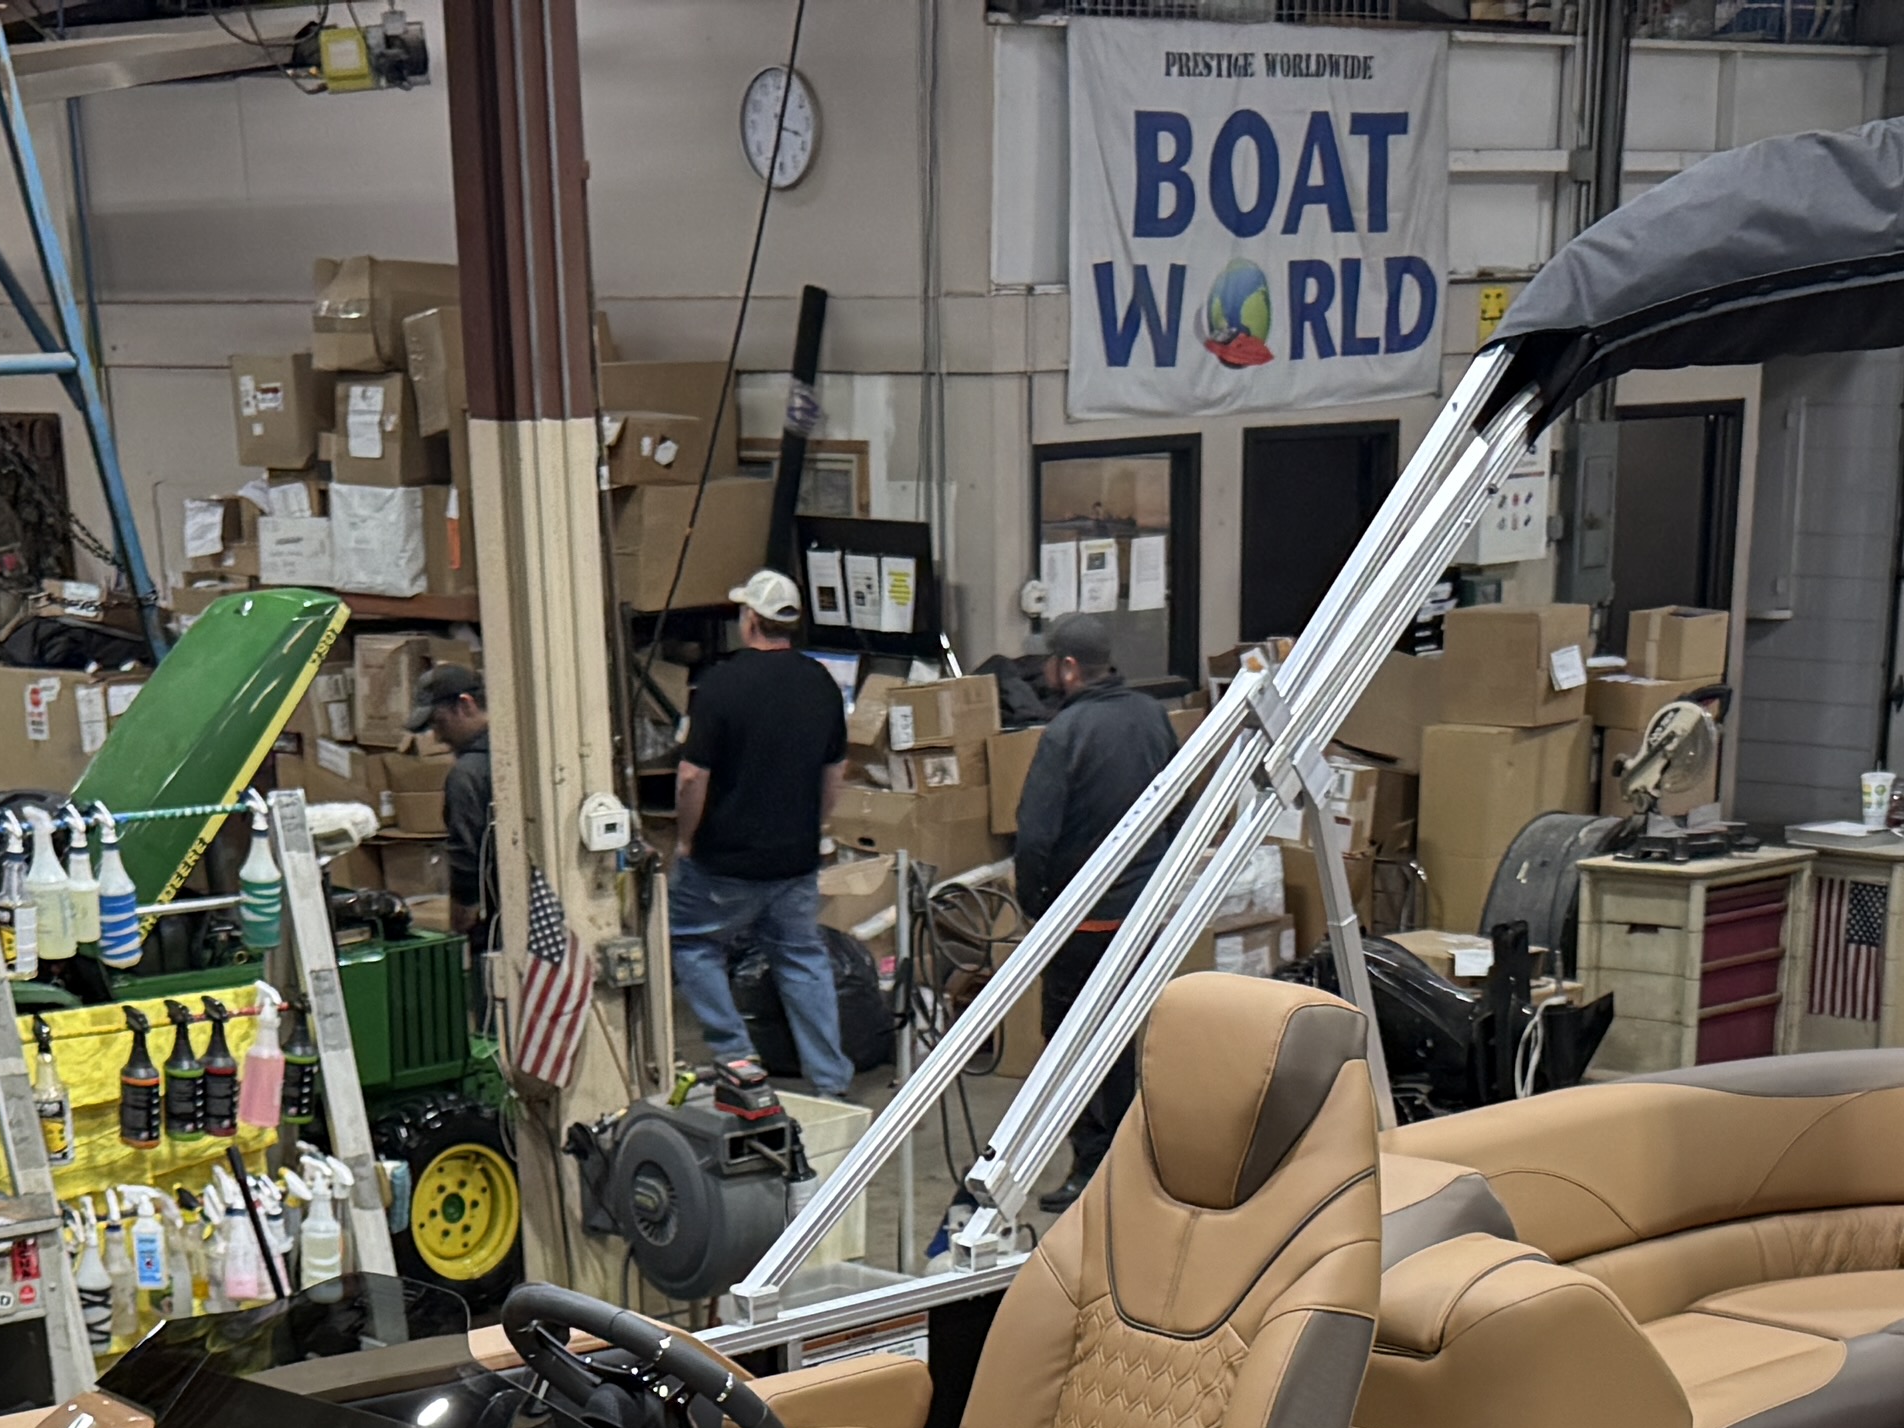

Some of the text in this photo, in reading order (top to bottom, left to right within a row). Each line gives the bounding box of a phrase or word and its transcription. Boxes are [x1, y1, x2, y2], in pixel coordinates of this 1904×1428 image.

[1164, 51, 1375, 81] PRESTIGE WORLDWIDE
[1132, 108, 1410, 240] BOAT
[1092, 254, 1438, 369] WORLD
